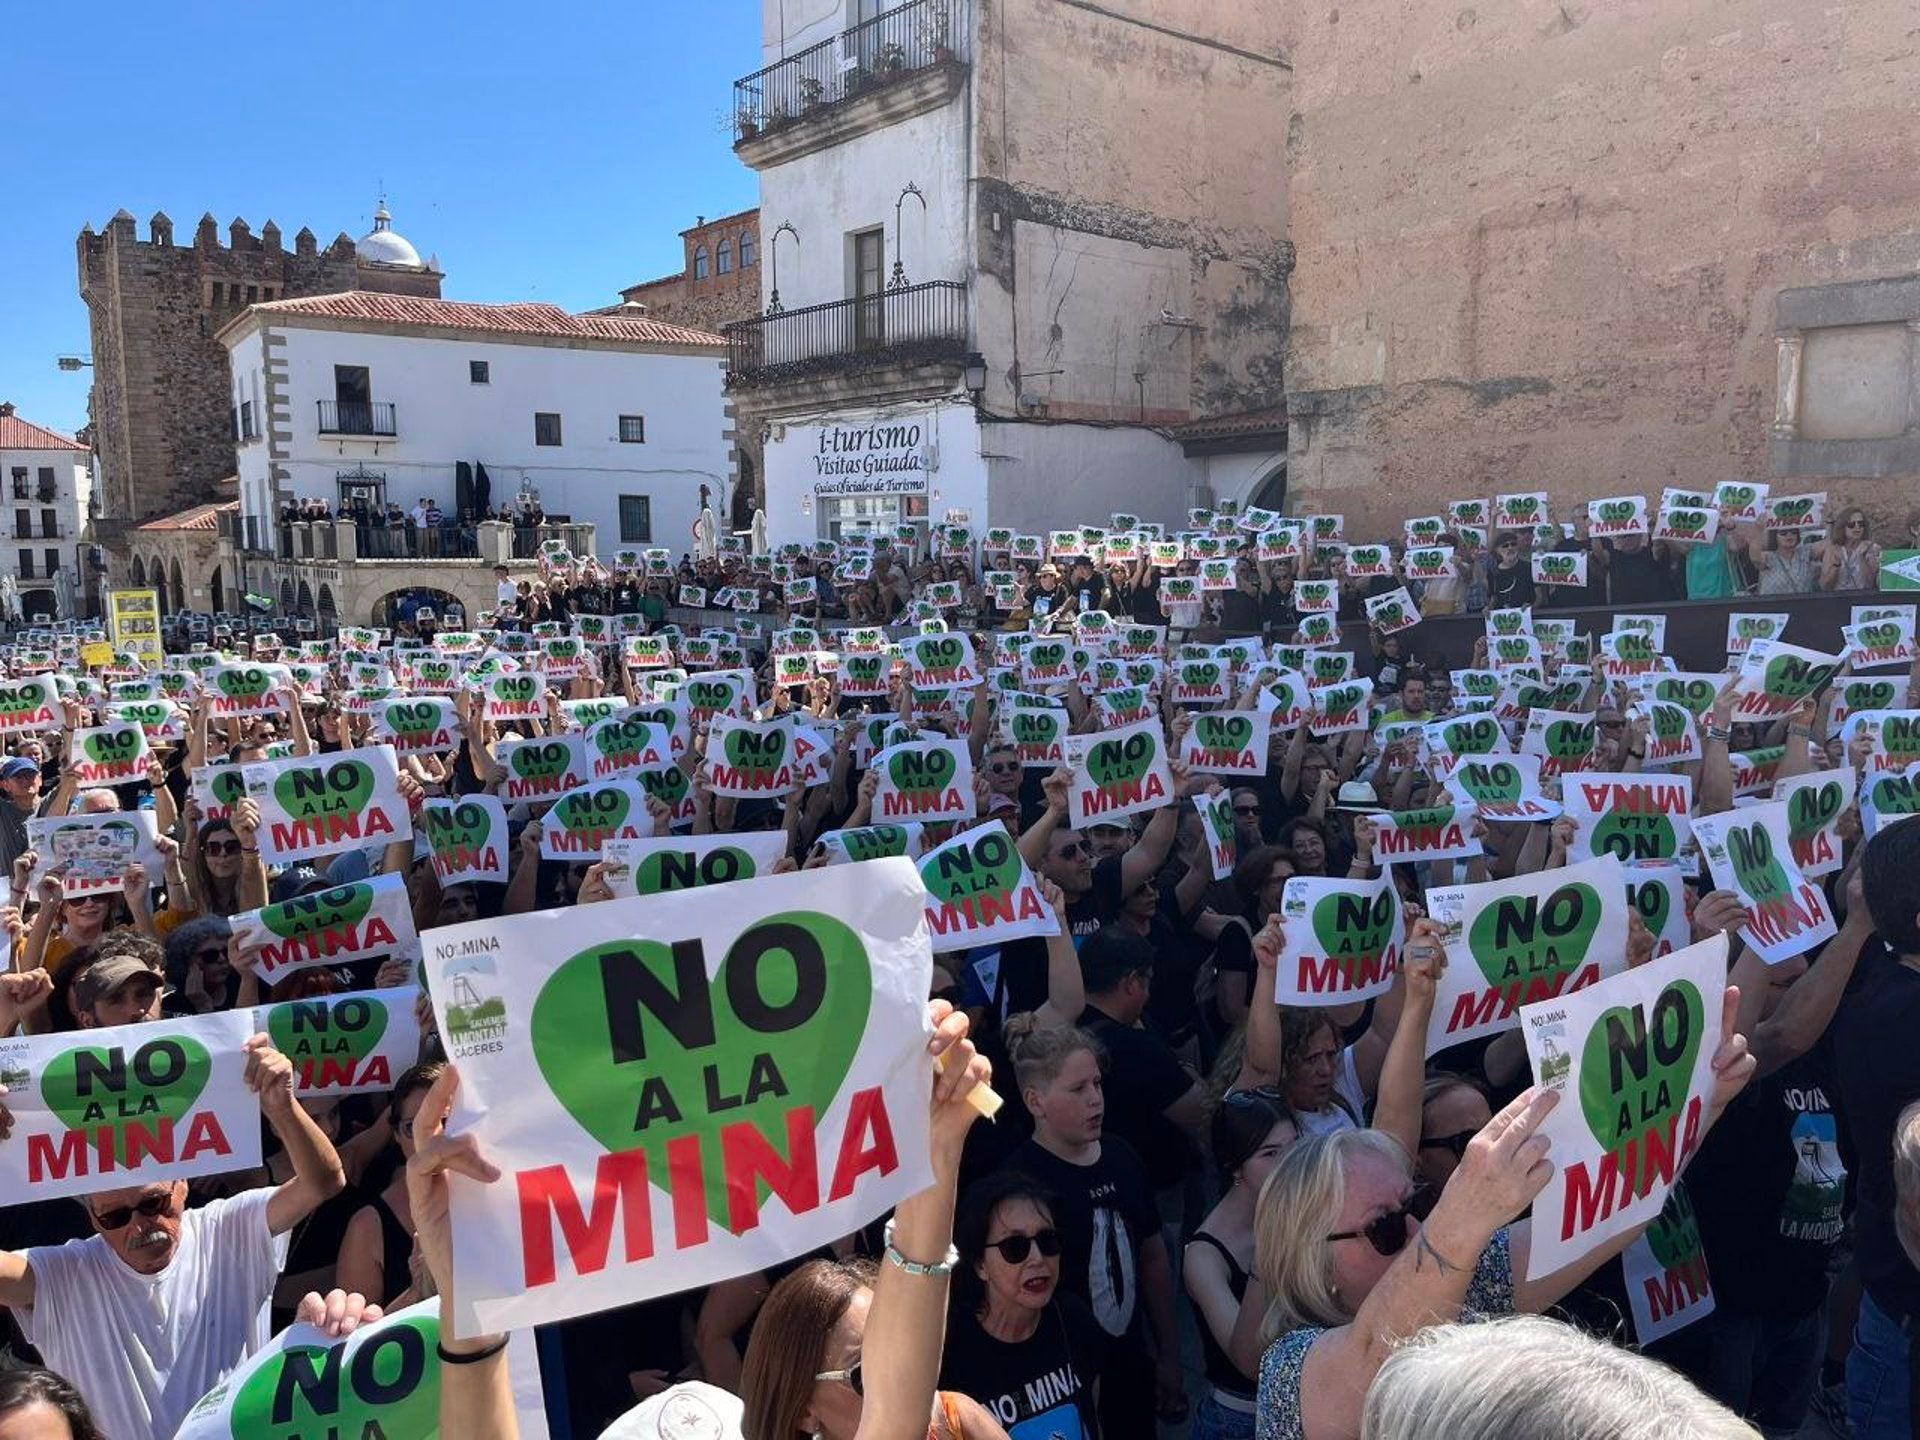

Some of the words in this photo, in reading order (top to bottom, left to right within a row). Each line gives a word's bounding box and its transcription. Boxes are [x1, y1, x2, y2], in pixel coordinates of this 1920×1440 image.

[819, 424, 920, 454] i-turismo
[813, 454, 861, 475] Visitas
[874, 479, 884, 492] de
[886, 478, 925, 492] Turismo
[554, 640, 575, 652] NO
[639, 639, 658, 650] NO
[925, 638, 956, 656] NO
[1857, 644, 1909, 664] MINA
[546, 656, 584, 668] MINA
[630, 653, 666, 664] MINA
[227, 668, 262, 686] NO
[502, 676, 531, 692] NO
[913, 666, 974, 686] MINA
[1667, 679, 1706, 698] NO
[215, 691, 281, 712] MINA
[1854, 682, 1888, 698] NO
[130, 704, 159, 718] NO
[399, 701, 433, 721] NO
[490, 701, 541, 716] MINA
[582, 704, 611, 717] NO
[1312, 708, 1361, 729] MINA
[605, 722, 642, 742] NO
[1021, 715, 1050, 732] NO
[1206, 716, 1244, 737] NO
[1454, 719, 1491, 742] NO
[95, 729, 134, 750] NO
[385, 729, 450, 751] MINA
[737, 728, 781, 755] NO
[1101, 734, 1146, 768] NO
[82, 751, 151, 780] MINA
[522, 743, 563, 766] NO
[594, 748, 660, 778] MINA
[754, 756, 773, 768] LA
[902, 748, 946, 775] NO
[1188, 747, 1257, 770] MINA
[294, 763, 360, 798] NO
[508, 772, 578, 798] MINA
[644, 766, 682, 793] NO
[712, 762, 791, 792] MINA
[904, 777, 915, 789] A
[918, 775, 936, 787] LA
[1103, 770, 1113, 783] A
[1117, 764, 1136, 779] LA
[1469, 763, 1512, 787] NO
[302, 802, 315, 815] A
[322, 797, 348, 812] LA
[569, 788, 619, 814] NO
[883, 788, 966, 816] MINA
[1082, 772, 1166, 817] MINA
[1582, 783, 1687, 815] MINA
[1802, 782, 1837, 821] NO
[427, 801, 481, 831] NO
[572, 816, 583, 827] A
[588, 814, 609, 827] LA
[1418, 812, 1438, 825] LA
[270, 806, 395, 853] MINA
[856, 825, 899, 849] NO
[1380, 824, 1466, 854] MINA
[937, 834, 1009, 879] NO
[1740, 821, 1768, 872] NO
[433, 845, 500, 878] MINA
[659, 847, 740, 890] NO
[951, 882, 965, 898] A
[970, 873, 999, 892] LA
[283, 884, 357, 919] NO
[925, 886, 1045, 936] MINA
[1336, 889, 1391, 933] NO
[293, 921, 308, 935] A
[315, 913, 344, 930] LA
[1496, 888, 1585, 950] NO
[1745, 883, 1827, 949] MINA
[260, 916, 397, 973] MINA
[436, 944, 455, 961] NO
[462, 935, 501, 956] MINA
[1338, 937, 1353, 954] A
[1360, 933, 1381, 952] LA
[1296, 943, 1397, 993] MINA
[1501, 955, 1520, 979] A
[1528, 946, 1561, 973] LA
[599, 922, 828, 1065] NO
[291, 998, 372, 1034] NO
[296, 1039, 312, 1055] A
[320, 1037, 351, 1054] LA
[1606, 987, 1690, 1096] NO
[75, 1039, 188, 1098] NO
[295, 1055, 393, 1091] INA
[633, 1076, 684, 1133] A
[702, 1052, 790, 1114] LA
[82, 1101, 106, 1123] A
[118, 1094, 162, 1118] LA
[1616, 1099, 1633, 1138] A
[1640, 1079, 1672, 1121] LA
[27, 1110, 233, 1183] MINA
[1560, 1094, 1703, 1243] MINA
[515, 1085, 900, 1289] MINA
[272, 1324, 426, 1425] NO
[1025, 1362, 1083, 1413] MINA
